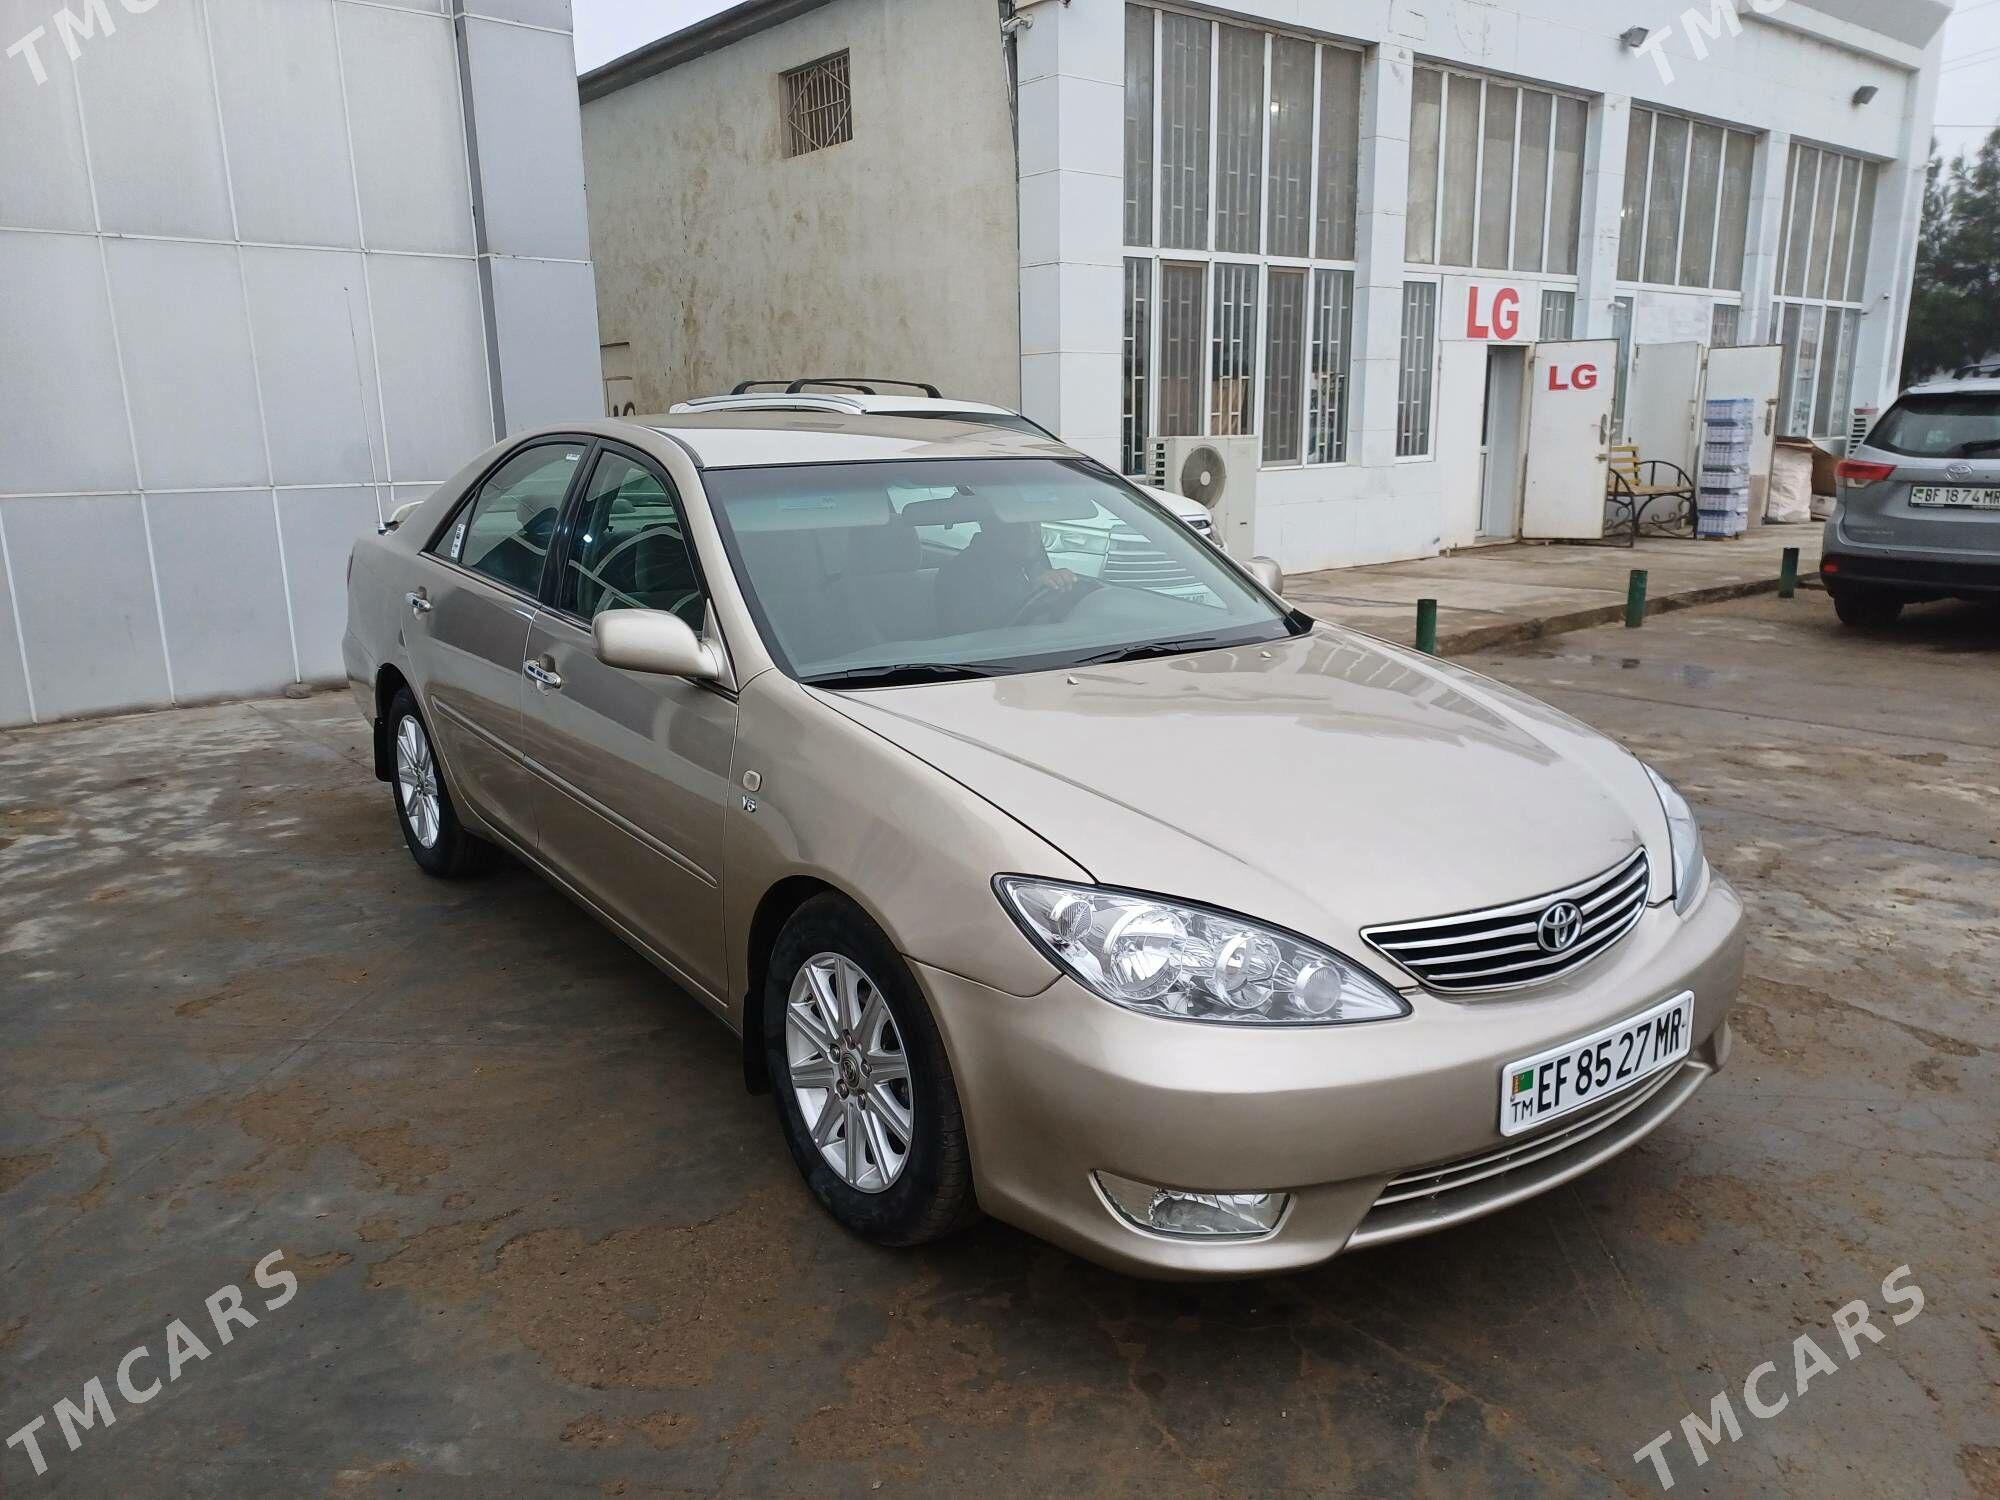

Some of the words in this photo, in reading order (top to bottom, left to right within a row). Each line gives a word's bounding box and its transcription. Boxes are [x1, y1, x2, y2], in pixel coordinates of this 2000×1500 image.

[1467, 286, 1519, 340] LG
[1549, 364, 1597, 391] LG
[1511, 1097, 1534, 1123] TM
